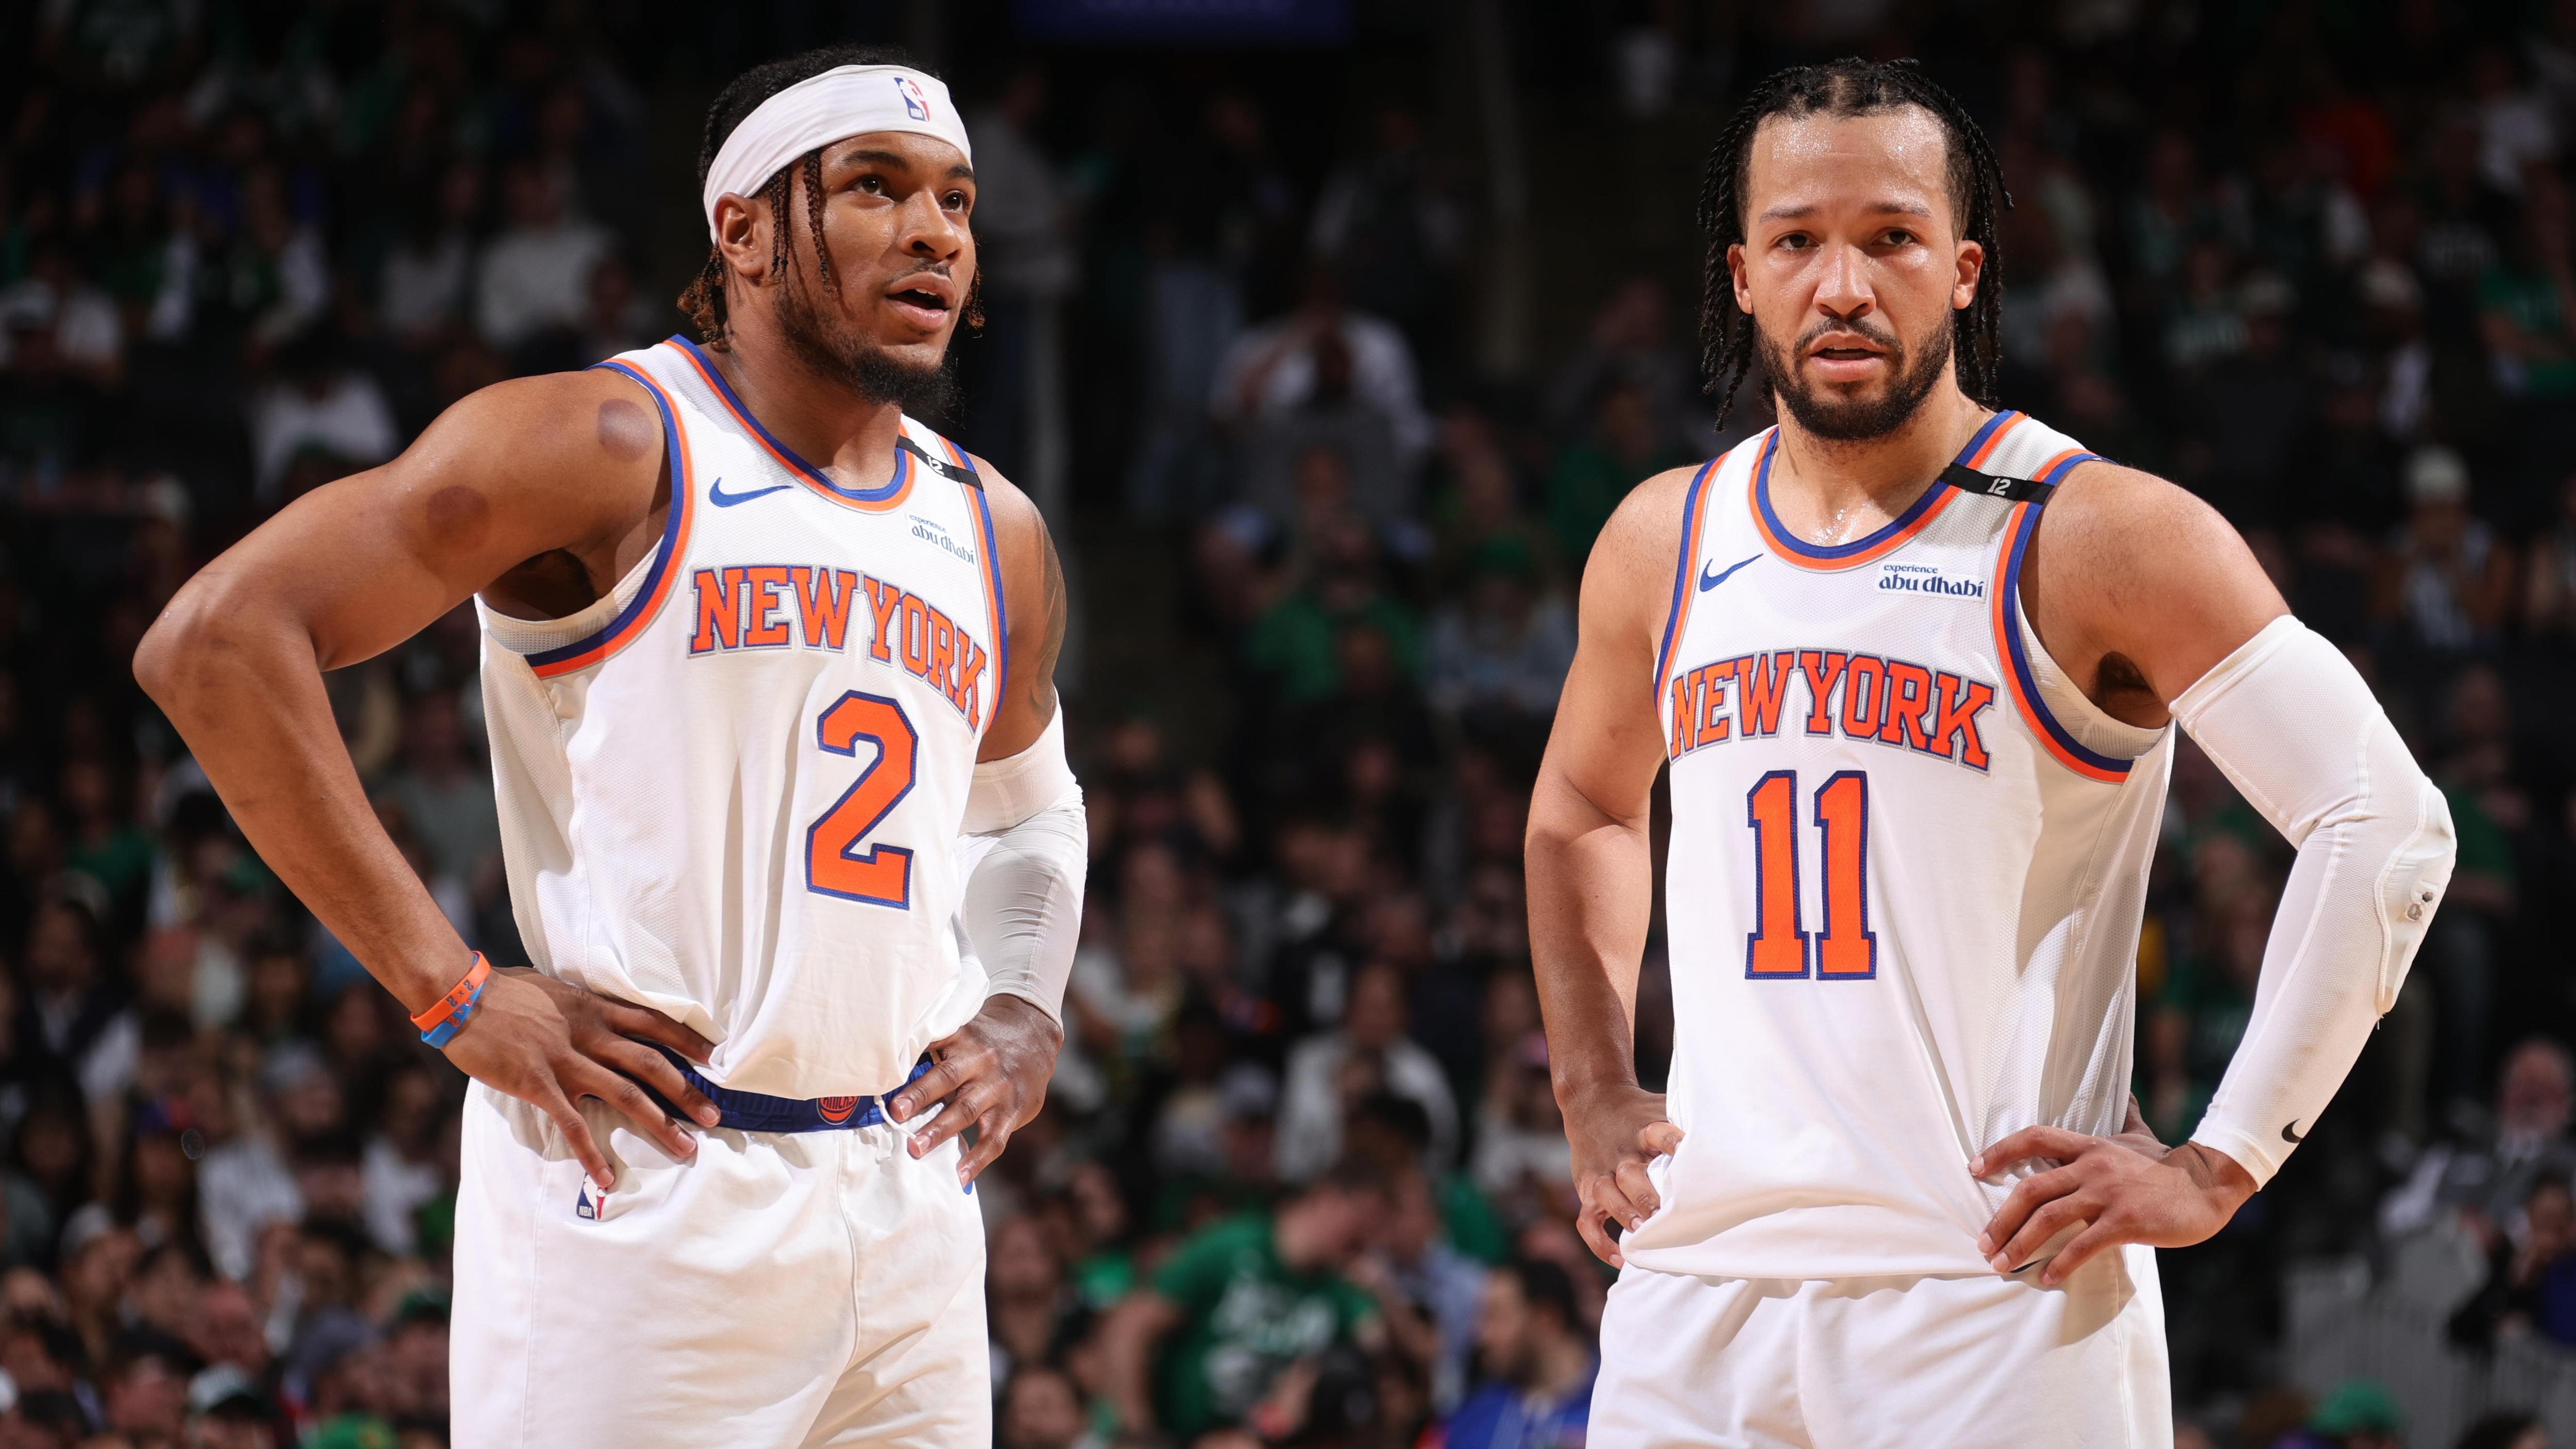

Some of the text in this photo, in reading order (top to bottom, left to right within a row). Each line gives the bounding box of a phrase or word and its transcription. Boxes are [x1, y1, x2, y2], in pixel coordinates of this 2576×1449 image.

[927, 455, 945, 476] 12
[1987, 478, 2011, 496] 12
[909, 515, 947, 533] experience
[911, 525, 975, 565] abu dhabi
[1884, 565, 1938, 574] experience
[1879, 573, 1985, 598] abu dhabi
[688, 565, 987, 740] NEW YORK
[1670, 647, 1997, 774] NEW YORK
[805, 689, 918, 910] 2
[1745, 770, 1877, 980] 11
[579, 1205, 592, 1218] NBA
